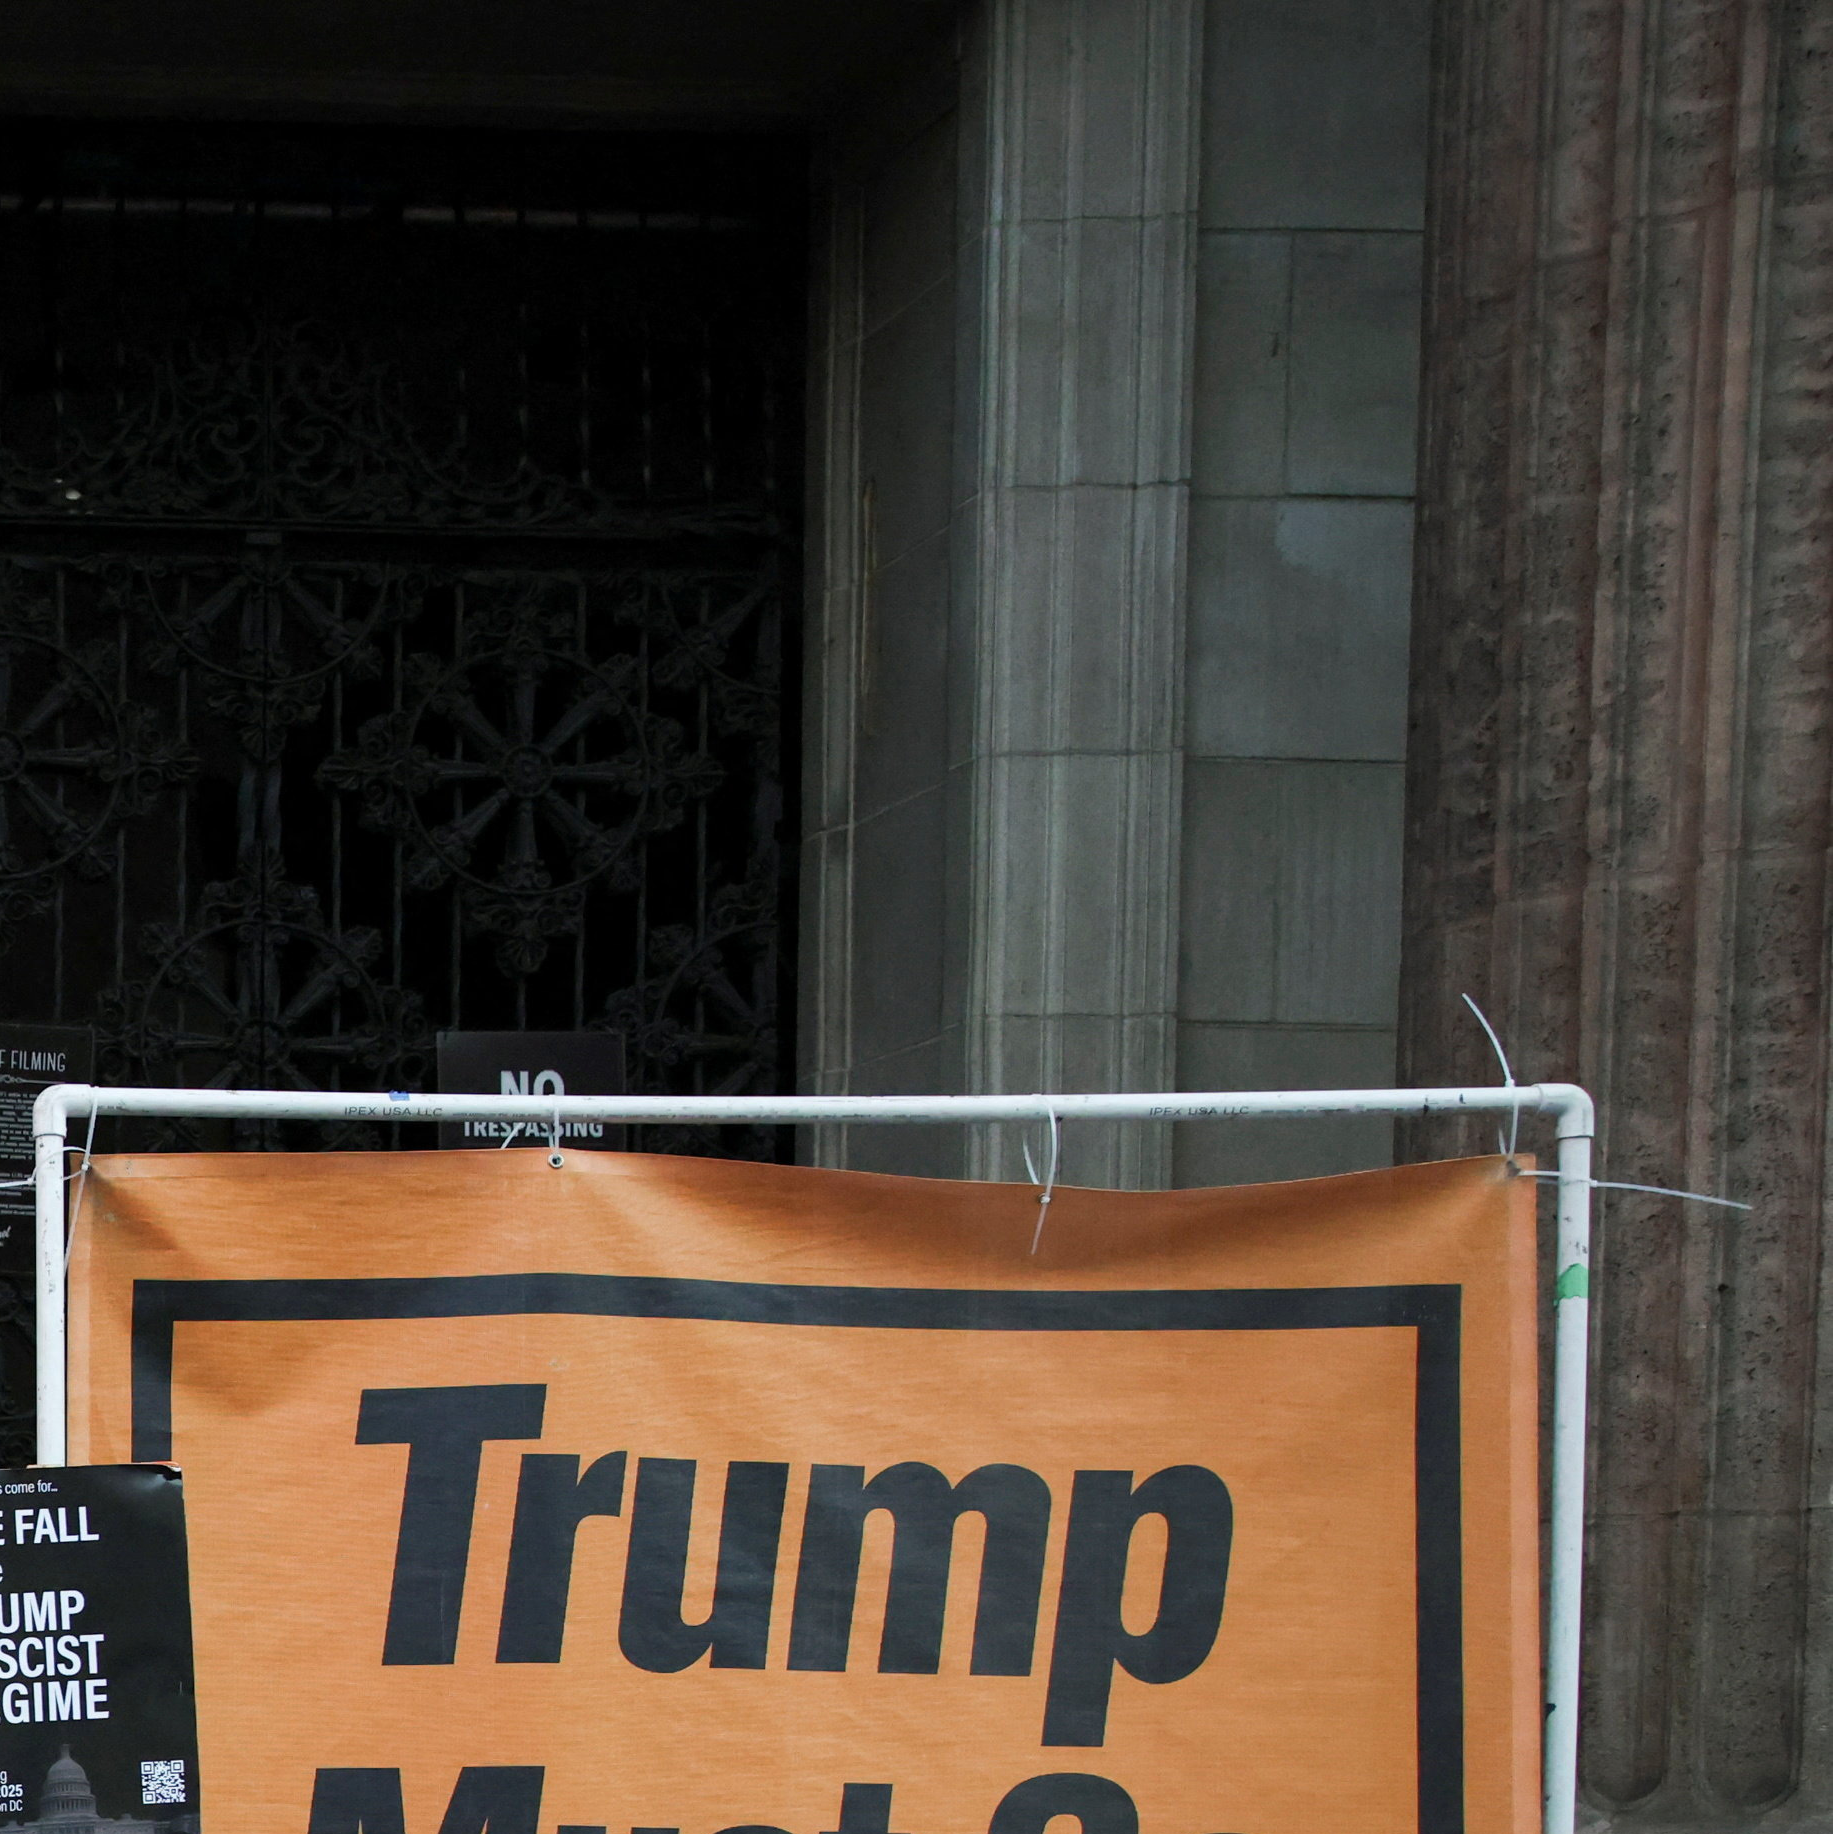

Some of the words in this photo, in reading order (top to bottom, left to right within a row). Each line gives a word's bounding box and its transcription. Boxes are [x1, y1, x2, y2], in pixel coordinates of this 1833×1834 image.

[11, 1050, 66, 1072] FILMING
[344, 1106, 377, 1117] IPEX
[382, 1107, 411, 1117] USA
[5, 1484, 34, 1494] come
[15, 1507, 99, 1544] FALL
[355, 1384, 1233, 1747] Trump
[10, 1800, 22, 1811] DC
